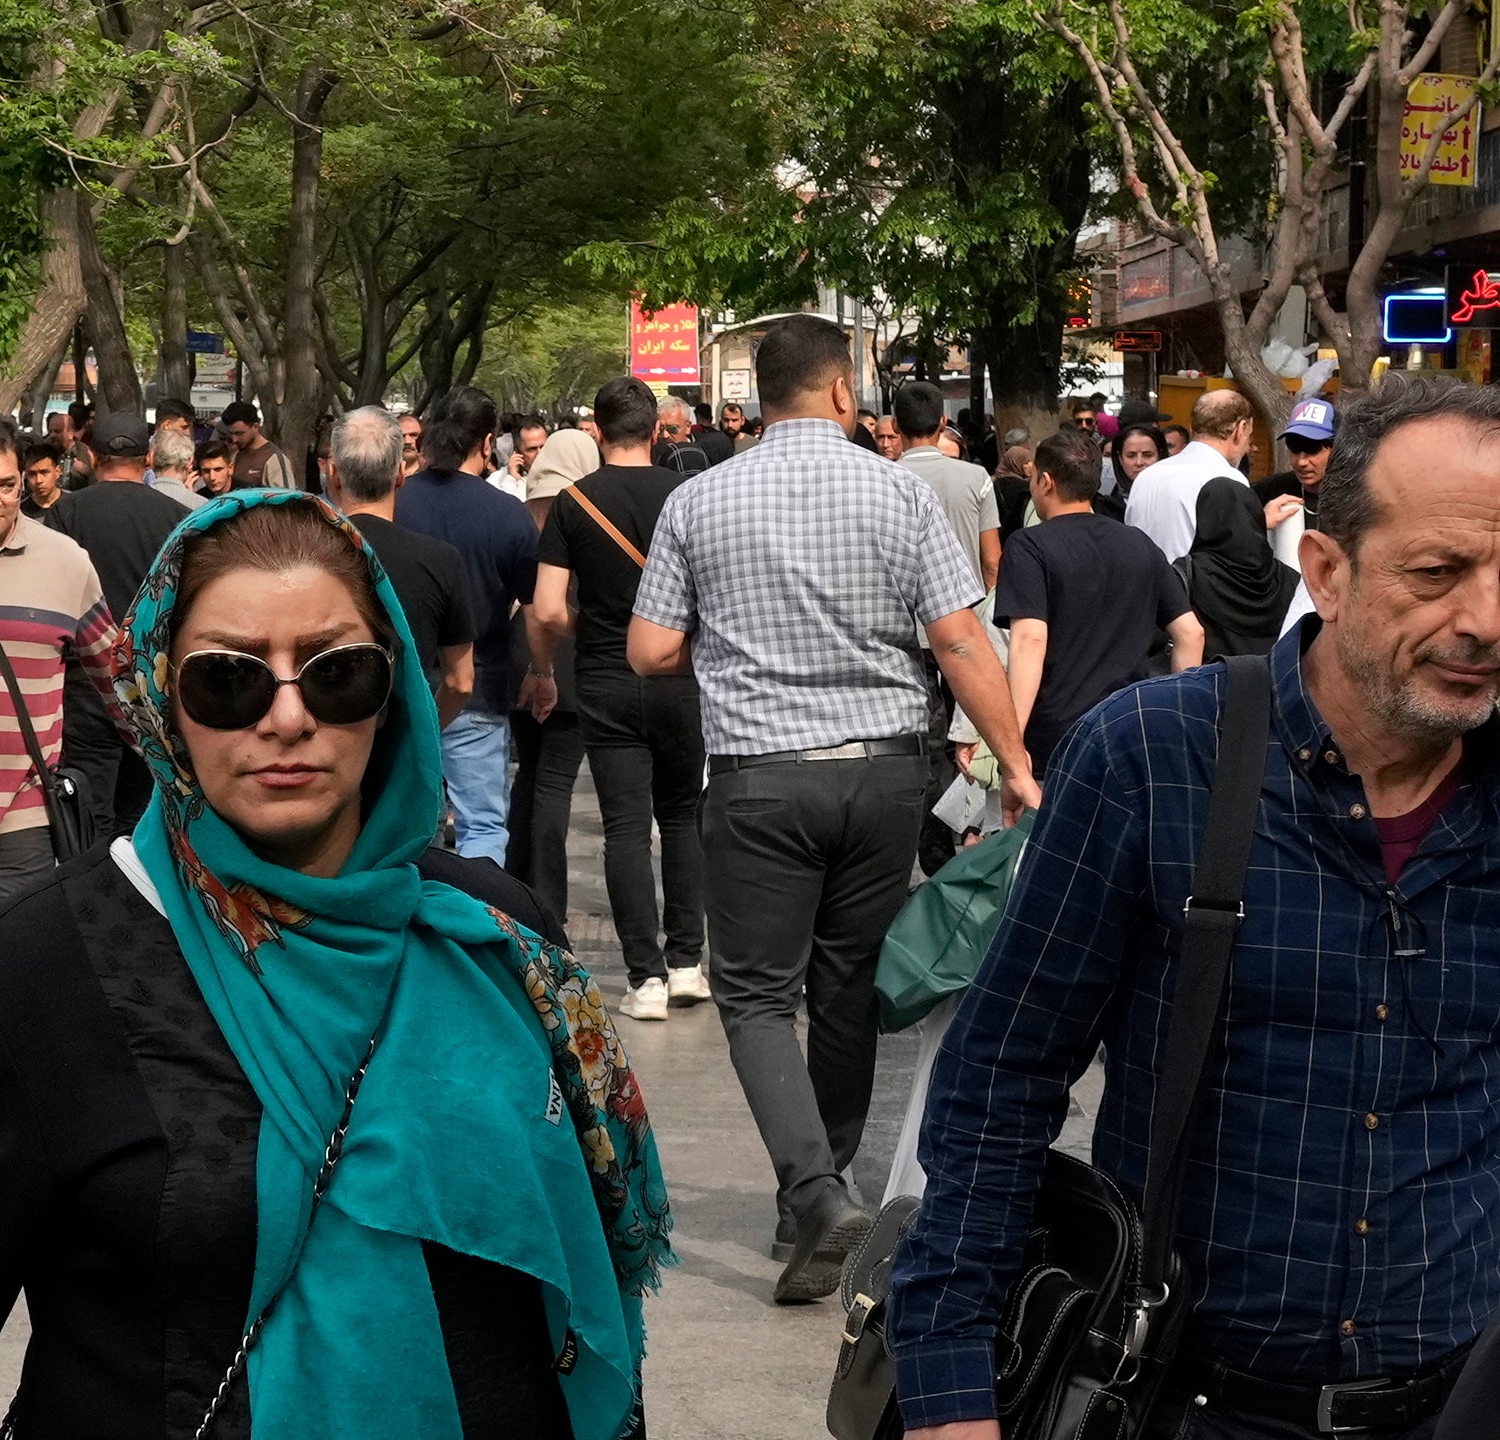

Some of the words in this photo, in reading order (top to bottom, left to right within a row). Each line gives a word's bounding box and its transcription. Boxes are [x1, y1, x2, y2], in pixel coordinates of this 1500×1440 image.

[635, 322, 641, 333] و
[643, 319, 671, 333] جواهر
[673, 322, 679, 333] و
[680, 319, 696, 330] طلا
[637, 339, 666, 355] ایران
[669, 339, 690, 351] سکه
